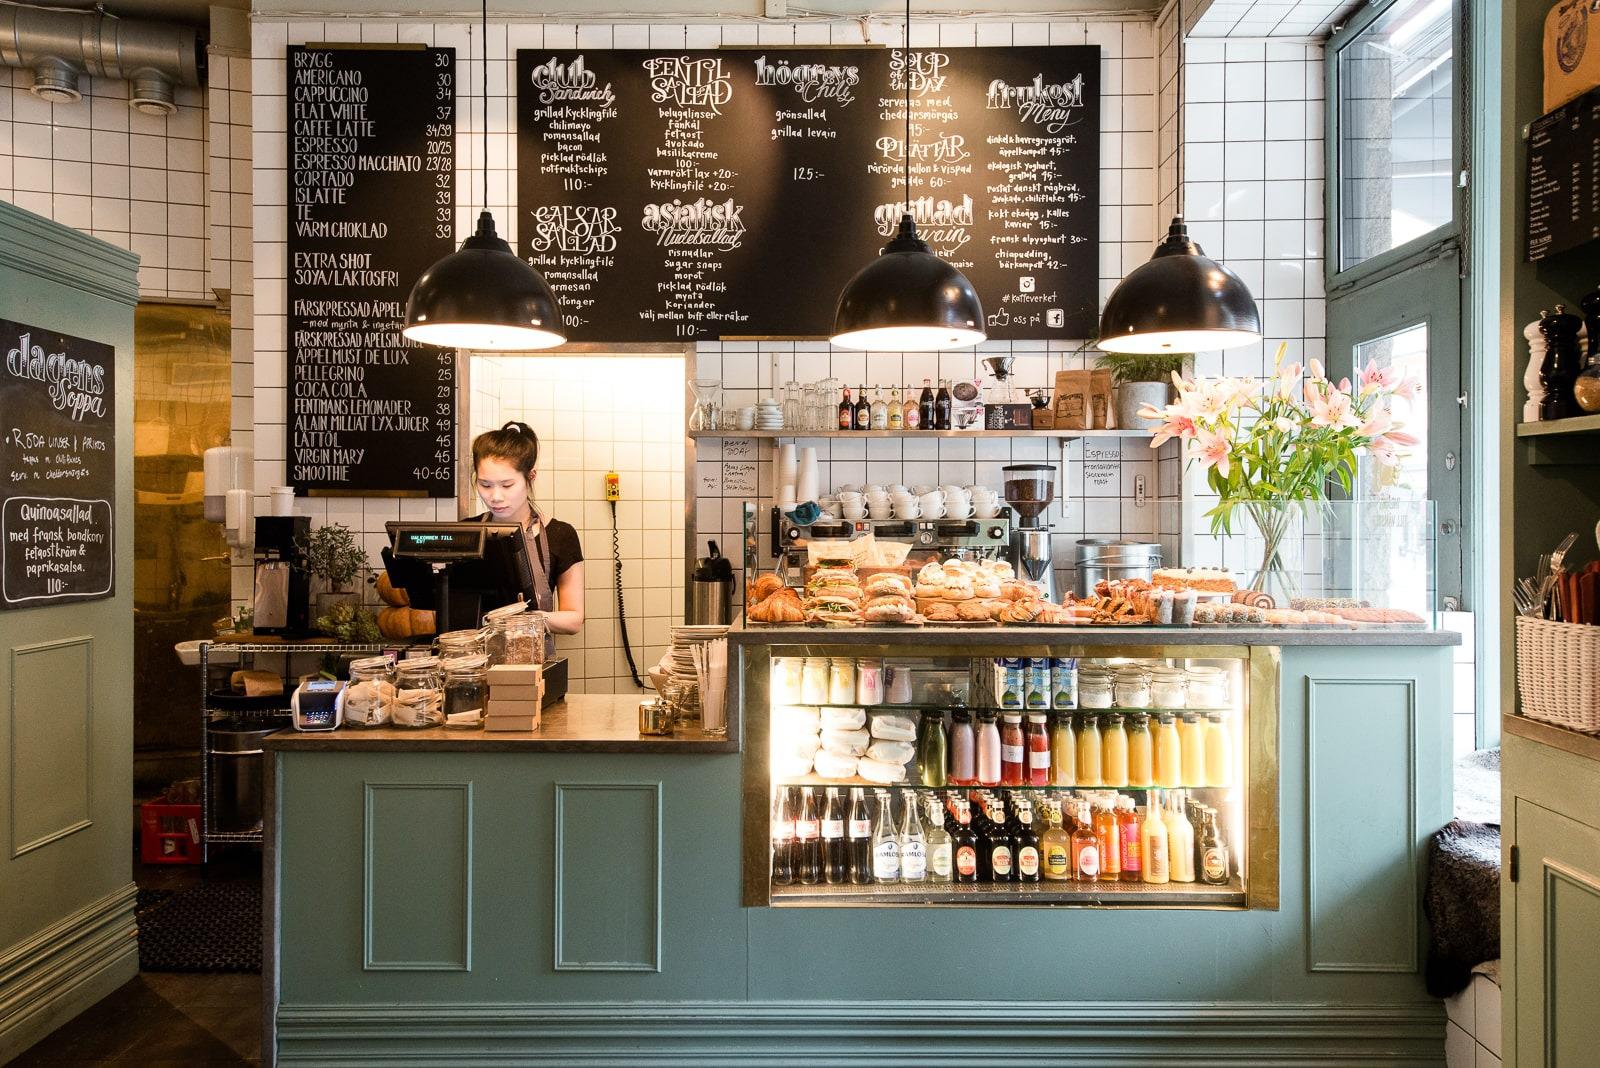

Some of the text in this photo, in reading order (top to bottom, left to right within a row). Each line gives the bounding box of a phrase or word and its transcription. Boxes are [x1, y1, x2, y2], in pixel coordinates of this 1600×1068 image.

[295, 53, 450, 68] BRYGG 30
[890, 48, 950, 79] SOUP
[295, 70, 450, 87] AMERICANO 30
[294, 86, 451, 103] CAPPUCCINO 34
[539, 79, 616, 108] Sandwich
[986, 73, 1085, 110] frukost
[926, 96, 952, 108] med
[295, 103, 451, 120] FLAT WHITE 37
[534, 106, 564, 122] grillad
[658, 108, 717, 120] belugalinser
[776, 108, 826, 122] grönsallad
[1019, 101, 1080, 134] Meny
[336, 120, 376, 137] LATTE
[426, 124, 452, 137] 34/39
[549, 120, 591, 132] chilimayo
[668, 120, 700, 130] fänkål
[772, 125, 836, 140] grillad levain
[544, 132, 600, 143] romansallad
[664, 129, 704, 140] fetaost
[295, 136, 452, 155] ESPRESSO 20/25
[558, 142, 582, 152] bacon
[664, 140, 704, 149] avokado
[541, 152, 608, 164] picklad rödlök
[656, 147, 718, 160] basilikacreme
[295, 154, 452, 172] ESPRESSO MACCHIATO 23/28
[541, 164, 608, 177] rotfruktschips
[941, 164, 972, 176] vispad
[988, 161, 1022, 173] ekologisk
[294, 171, 450, 188] CORTADO 32
[695, 168, 710, 178] lax
[1014, 182, 1042, 192] danskt
[436, 192, 450, 204] 39
[296, 204, 450, 222] TE 39
[642, 197, 746, 232] asiatisk
[296, 222, 450, 238] VARM CHOKLAD 39
[532, 222, 617, 256] SALLAD
[990, 234, 1020, 244] fransk
[295, 252, 372, 269] EXTRA SHOT
[668, 248, 714, 258] risnudlar
[528, 254, 614, 269] grillad kycklingfilé
[696, 261, 722, 272] snaps
[544, 269, 598, 282] romansallad
[674, 271, 704, 280] morot
[658, 282, 727, 292] picklad rödlök
[676, 292, 703, 302] mynta
[294, 299, 370, 317] FÄRSKPRESSAD
[658, 311, 684, 320] mellan
[332, 319, 358, 331] mynta
[294, 330, 362, 348] FÄRSKPRESSAD
[296, 347, 452, 365] ÄPPELMUST DE LUX 45
[6, 332, 104, 397] dagens
[294, 365, 452, 381] PELLEGRINO 25
[294, 382, 450, 398] COCA COLA 29
[53, 378, 106, 422] Soppa
[294, 398, 450, 415] FENTIMANS LEMONADER 38
[294, 415, 450, 432] ALAIN MILLIAT LYX JUICER 49
[294, 431, 450, 448] LÄTTÖL 45
[294, 448, 450, 464] VIRGIN MARY 45
[294, 466, 450, 482] SMOOTHIE 40-65
[20, 504, 92, 524] Quinoasallad
[10, 526, 104, 544] med fransk bondkorv
